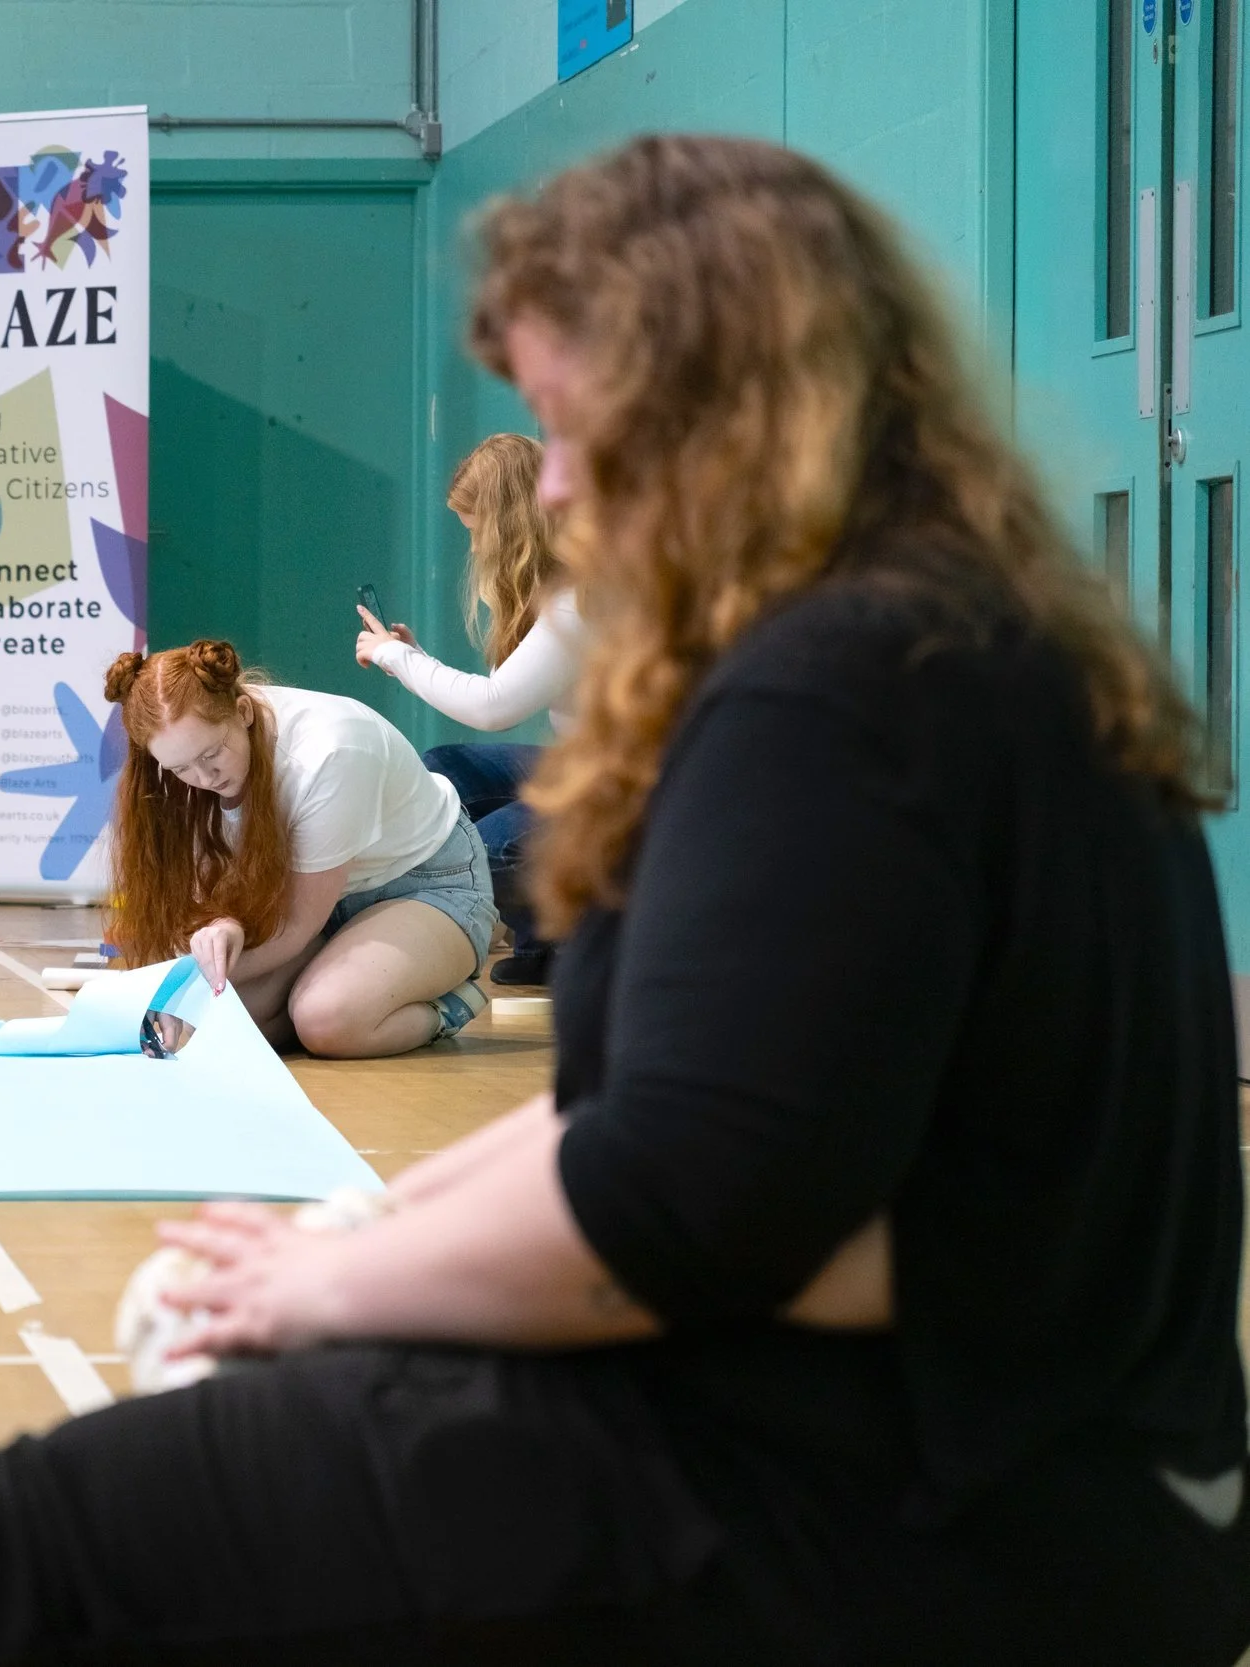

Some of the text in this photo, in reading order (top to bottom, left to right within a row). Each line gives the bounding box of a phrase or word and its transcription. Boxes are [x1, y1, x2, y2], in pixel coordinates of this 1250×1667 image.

[6, 477, 110, 501] Citizens
[1, 729, 63, 741] @blazearts
[1, 778, 58, 790] Blaze Arts
